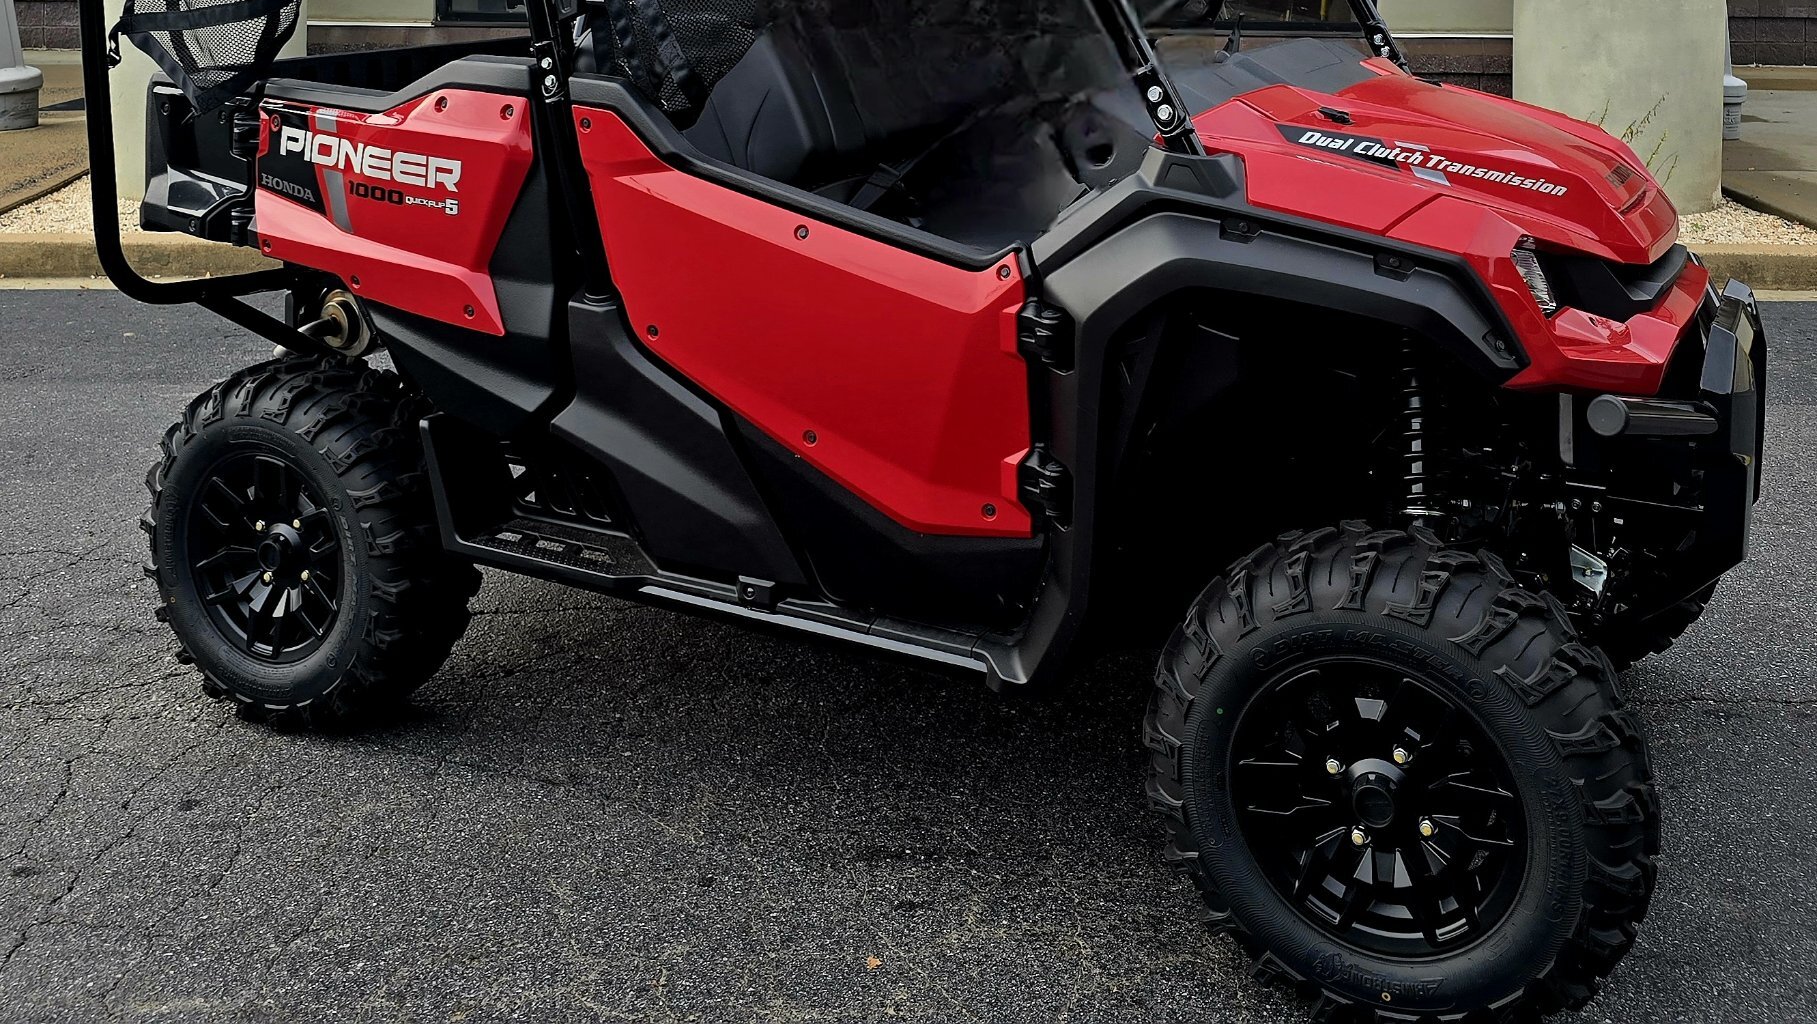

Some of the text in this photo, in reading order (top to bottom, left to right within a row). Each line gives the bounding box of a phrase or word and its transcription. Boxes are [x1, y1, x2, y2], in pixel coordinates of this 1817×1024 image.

[279, 125, 462, 193] PIONEER
[1298, 130, 1568, 197] Dual Clutch Transmission
[261, 172, 316, 203] HONDA
[348, 180, 404, 206] 1000
